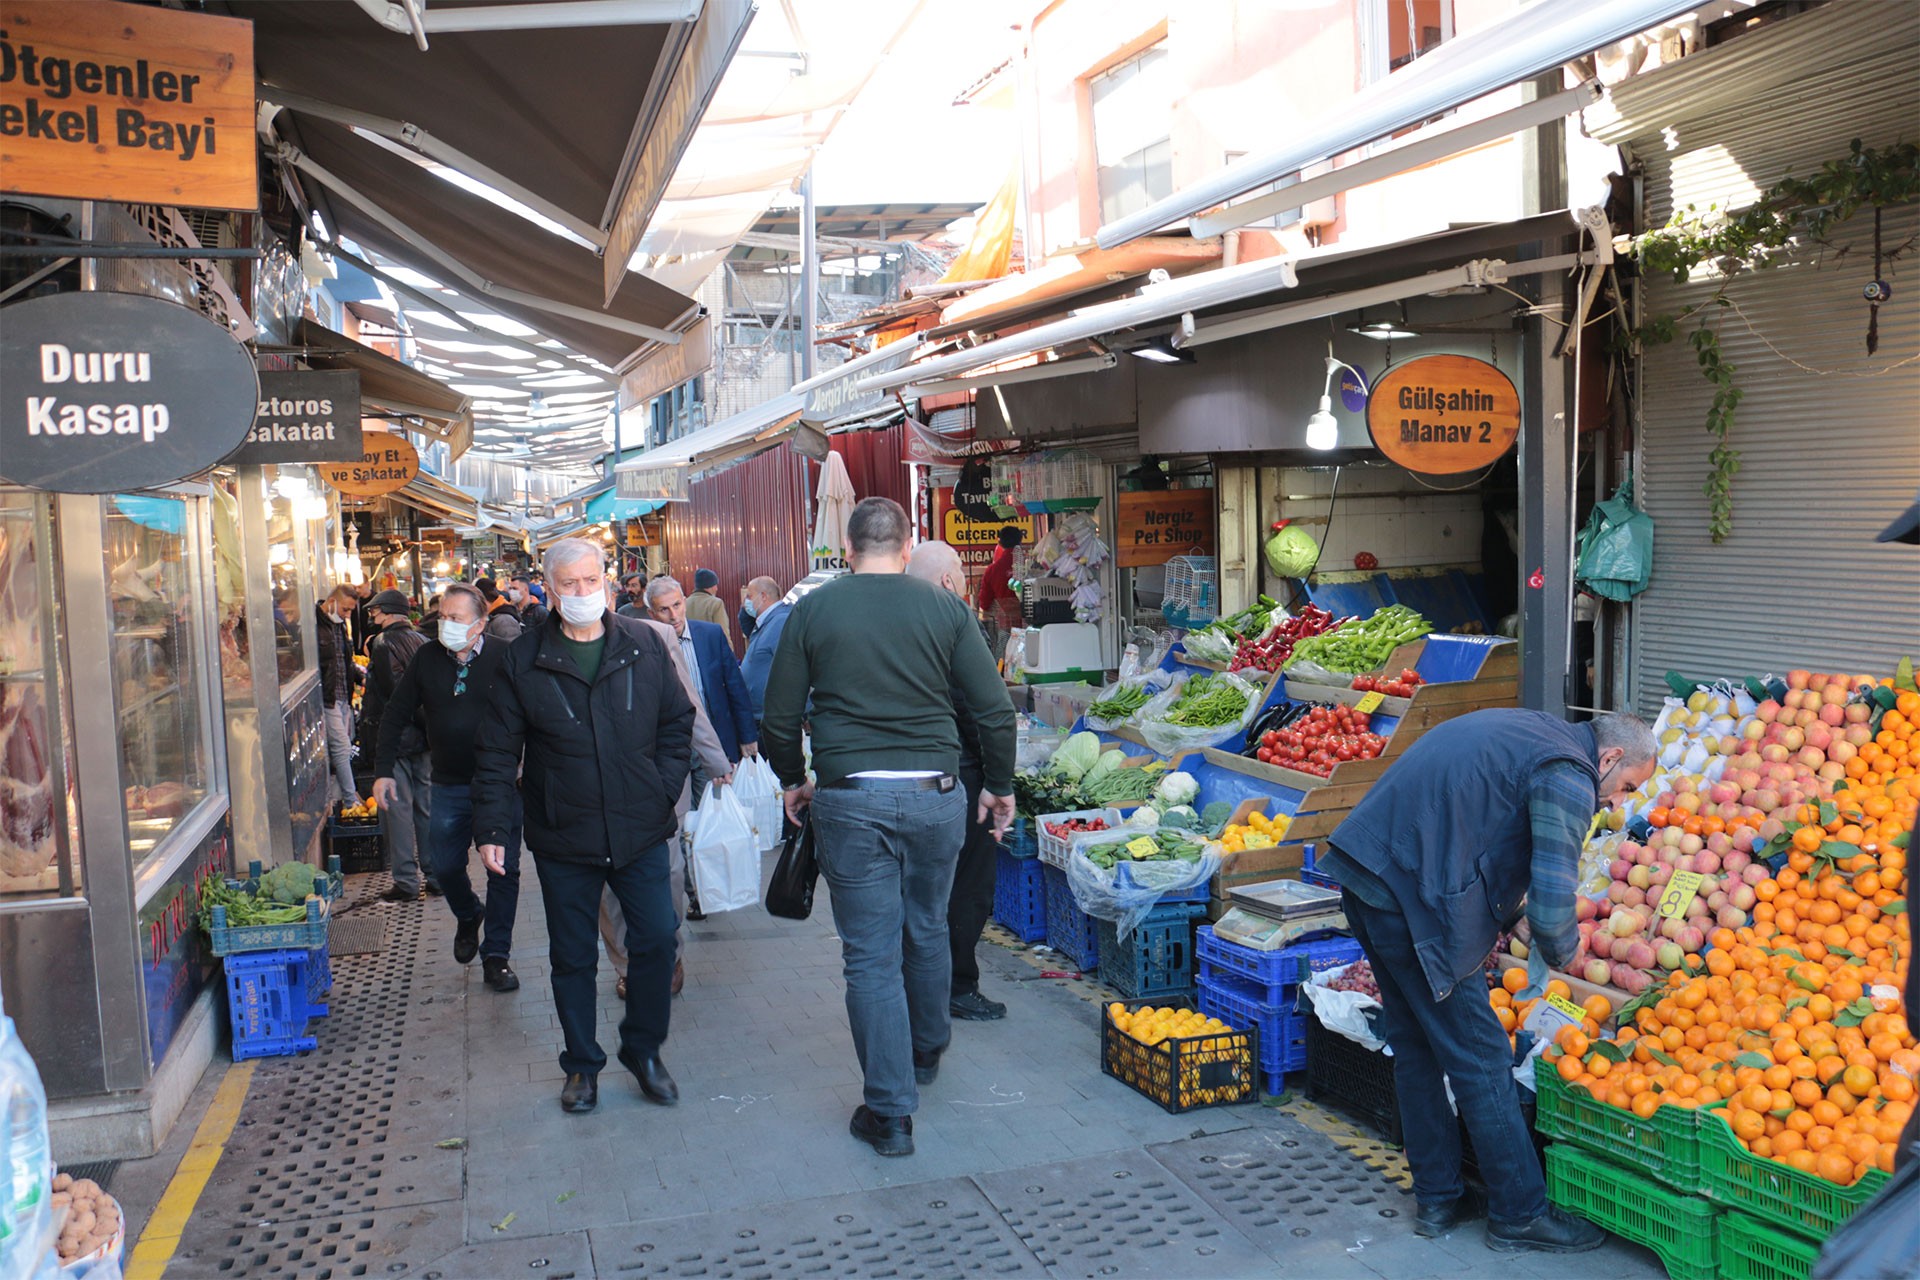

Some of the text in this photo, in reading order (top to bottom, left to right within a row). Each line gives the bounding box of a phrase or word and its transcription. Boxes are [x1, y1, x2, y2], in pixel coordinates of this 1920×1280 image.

[0, 98, 216, 161] ekel Bayi
[40, 343, 151, 383] Duru
[257, 396, 333, 417] ztoros
[1398, 386, 1494, 416] Gülşahin
[26, 396, 170, 442] Kasap
[1400, 419, 1492, 443] Manav 2
[385, 449, 400, 462] Et
[331, 466, 408, 482] ve Sakatat
[1144, 508, 1194, 527] Nergiz
[1134, 527, 1203, 545] Pet Shop
